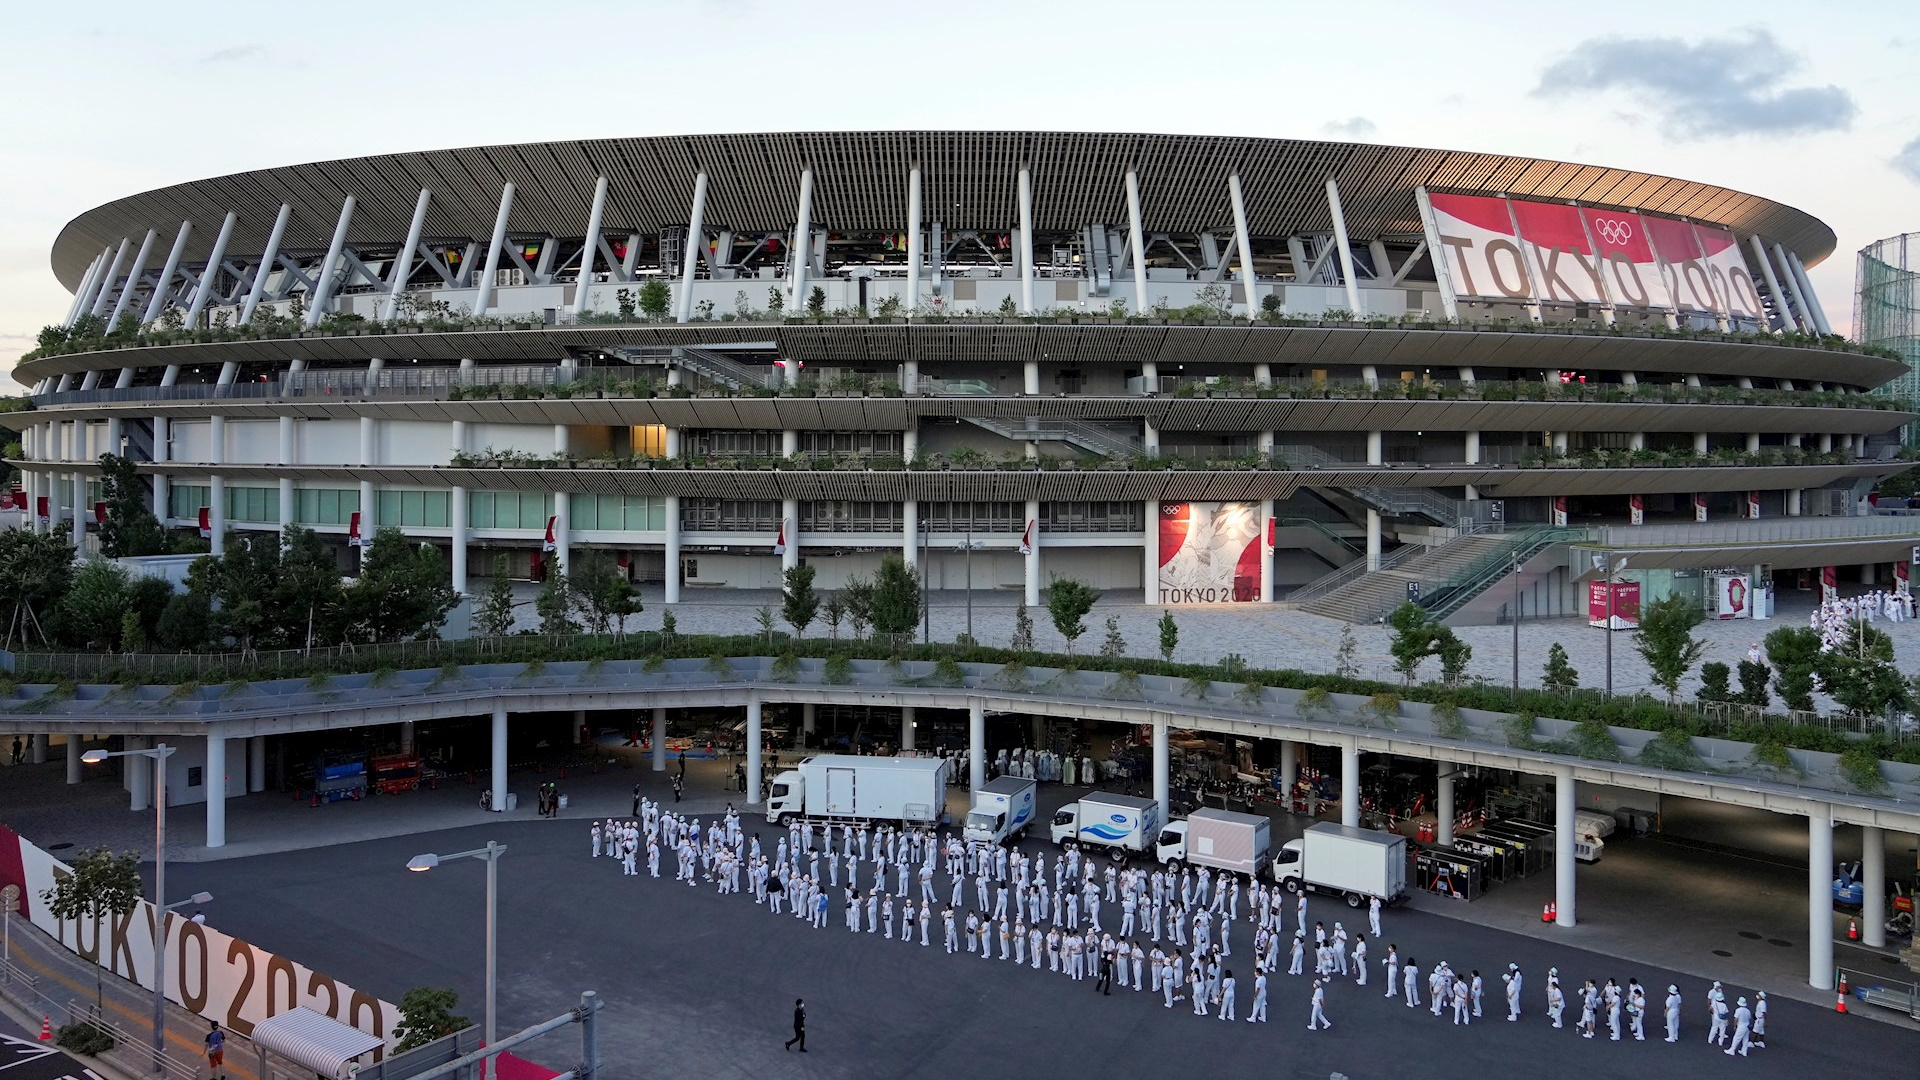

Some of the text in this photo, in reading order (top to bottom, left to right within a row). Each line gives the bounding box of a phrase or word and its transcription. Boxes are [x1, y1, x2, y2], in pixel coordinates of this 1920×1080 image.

[1440, 235, 1762, 319] TOKYO 2020
[1161, 587, 1261, 603] TOKYO 2020
